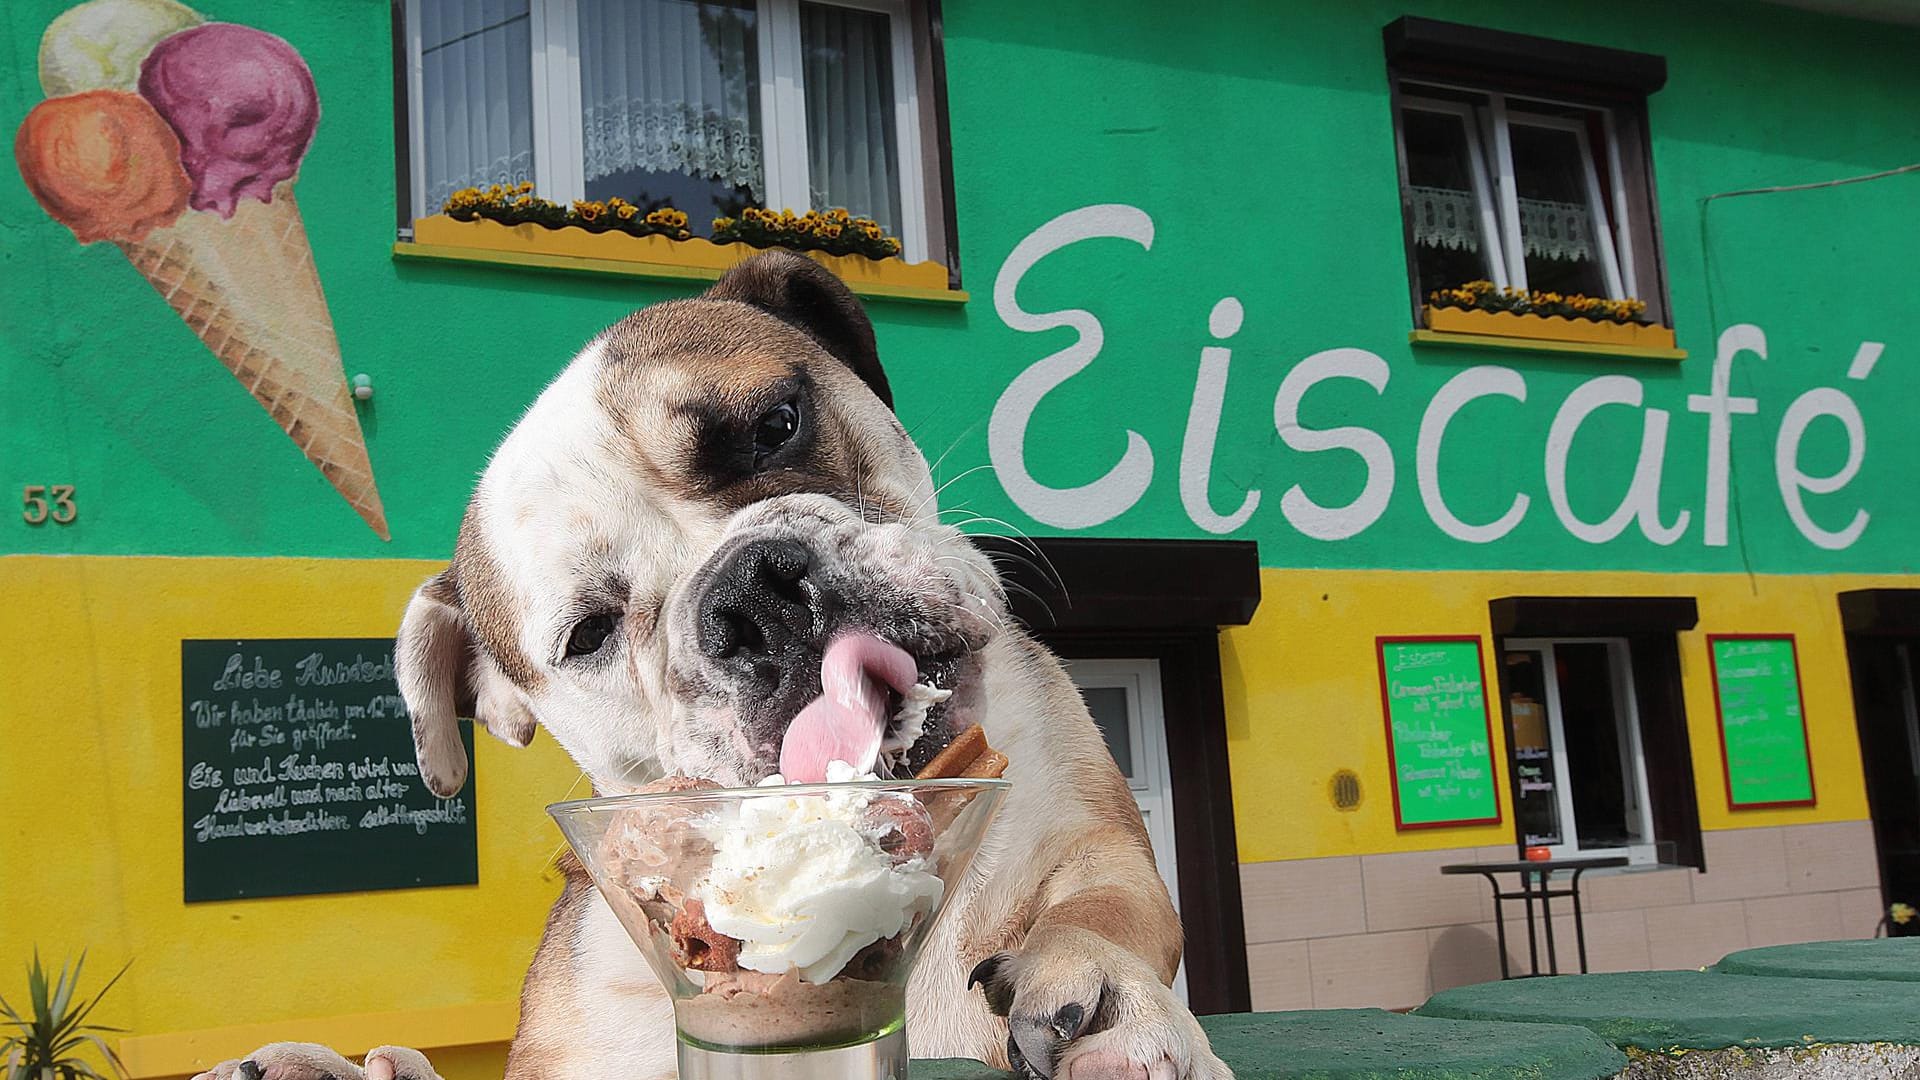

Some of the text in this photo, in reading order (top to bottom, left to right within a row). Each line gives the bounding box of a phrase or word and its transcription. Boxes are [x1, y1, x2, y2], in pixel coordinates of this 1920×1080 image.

[987, 202, 1885, 551] Eiscafé
[23, 484, 77, 524] 53
[213, 651, 396, 691] Liebe Kundsch
[190, 699, 227, 728] Wir
[231, 698, 283, 723] haben
[284, 694, 340, 726] täglich
[230, 719, 358, 752] für Sie geöffnet.
[188, 761, 224, 789] Eis
[233, 756, 276, 785] und
[277, 754, 344, 781] Kuchen
[347, 756, 391, 780] wird
[290, 782, 323, 806] und
[325, 781, 364, 803] nach
[365, 778, 410, 801] alter
